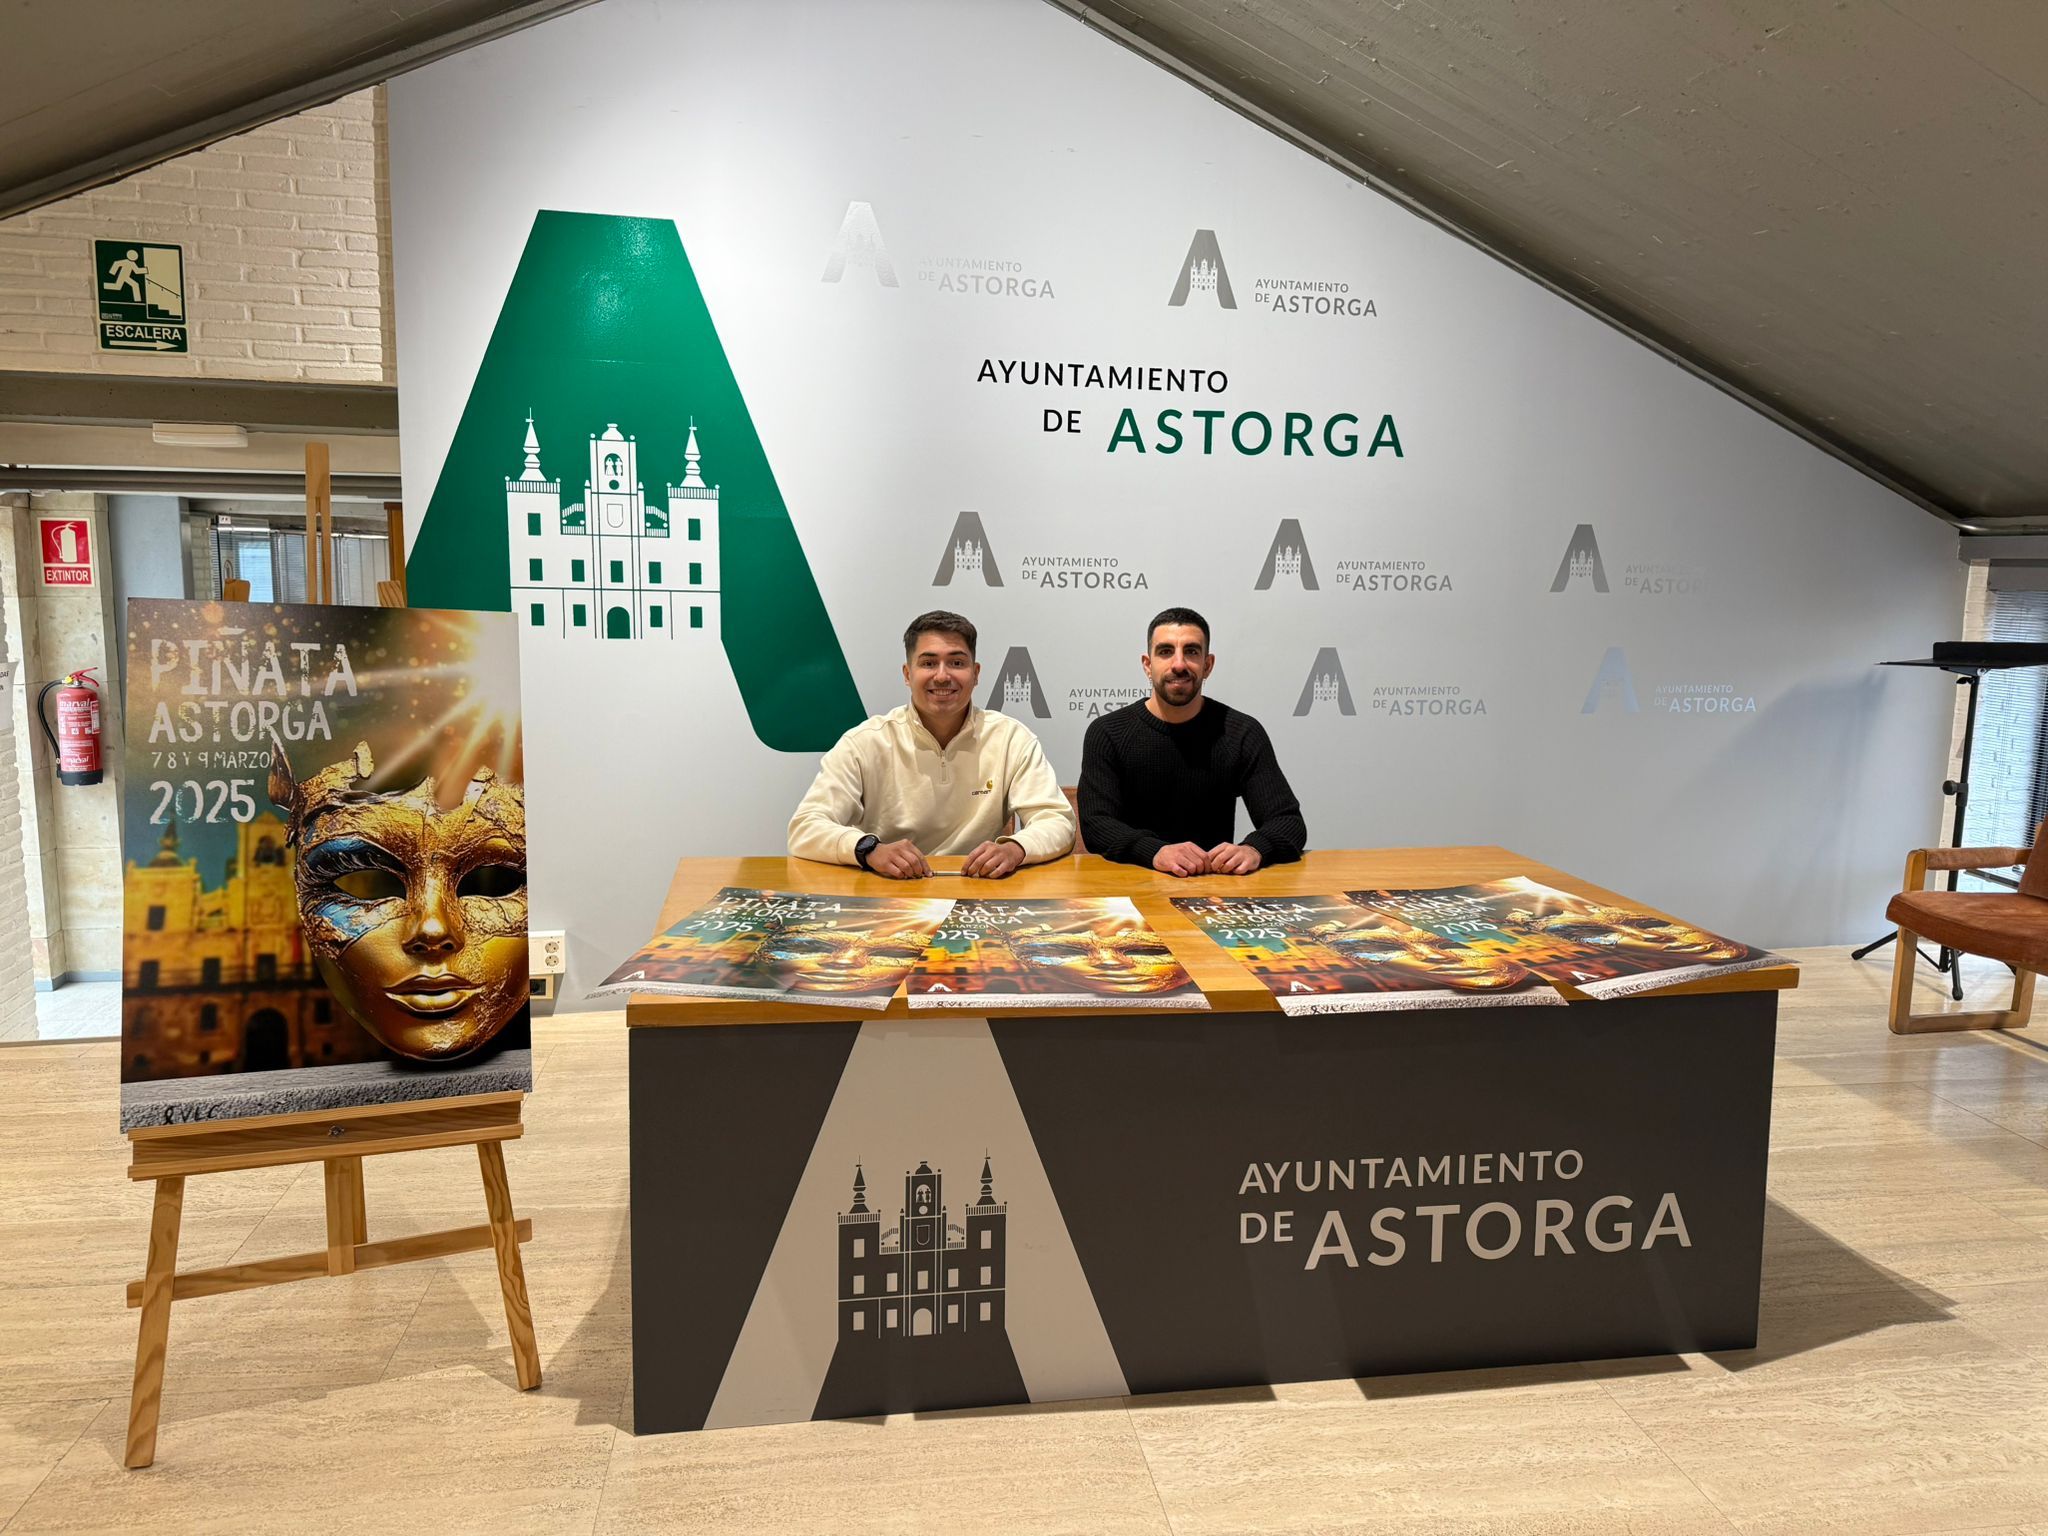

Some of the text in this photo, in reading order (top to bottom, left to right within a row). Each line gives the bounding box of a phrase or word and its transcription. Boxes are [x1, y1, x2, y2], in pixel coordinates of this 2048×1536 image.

[920, 256, 1022, 273] AYUNTAMIENTO
[918, 271, 1055, 299] DE ASTORGA
[1255, 279, 1349, 293] AYUNTAMIENTO
[1255, 292, 1378, 317] DE ASTORGA
[106, 324, 182, 340] ESCALERA
[977, 358, 1229, 394] AYUNTAMIENTO
[1043, 407, 1404, 458] DE ASTORGA
[1022, 556, 1119, 567] AYUNTAMIENTO
[1336, 560, 1426, 570] AYUNTAMIENTO
[46, 570, 90, 581] EXTINTOR
[1022, 570, 1149, 589] DE ASTORGA
[1336, 573, 1453, 591] DE ASTORGA
[1624, 576, 1639, 586] DE
[150, 627, 358, 698] PIÑATA
[1069, 688, 1153, 698] AYUNTAMIENT
[1373, 686, 1461, 696] AYUNTAMIENTO
[1655, 684, 1734, 694] AYUNTAMIENTO
[1069, 701, 1084, 711] DE
[1373, 699, 1487, 716] DE ASTORGA
[1654, 696, 1756, 713] DE ASTORGA
[148, 700, 333, 744] ASTORGA
[151, 751, 270, 769] 7 8 Y 9 MARZO
[149, 779, 256, 825] 2025
[685, 920, 758, 933] 2025
[947, 914, 1024, 925] TORGA
[1433, 919, 1498, 935] 2025
[1217, 927, 1287, 940] 2025
[1238, 1149, 1584, 1195] AYUNTAMIENTO
[1239, 1192, 1693, 1271] DE ASTORGA
